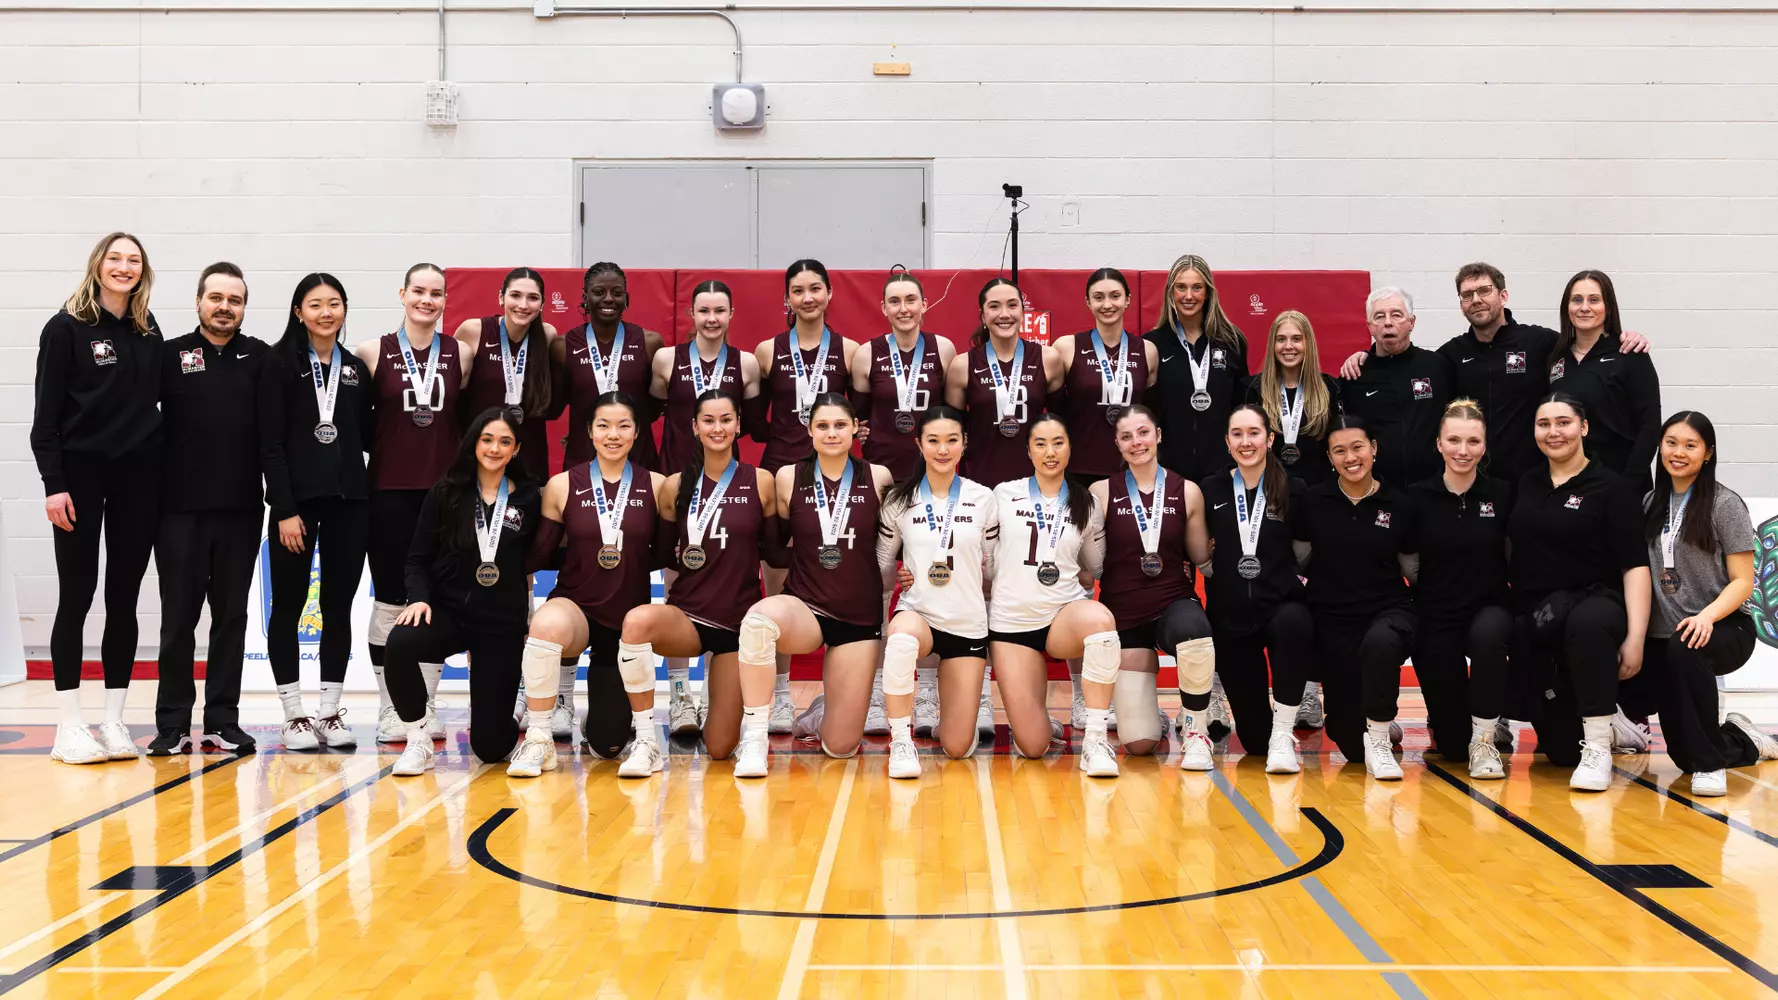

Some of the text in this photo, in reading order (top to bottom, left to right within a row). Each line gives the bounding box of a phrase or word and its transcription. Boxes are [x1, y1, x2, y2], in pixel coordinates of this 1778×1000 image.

[394, 362, 448, 370] McASER
[405, 351, 417, 375] OUA
[516, 349, 525, 374] OUA
[580, 354, 634, 364] McAER
[591, 346, 601, 371] OUA
[794, 352, 804, 378] OUA
[881, 362, 934, 372] McAER
[892, 353, 902, 376] OUA
[1087, 359, 1138, 368] McASER
[313, 362, 323, 388] OUA
[682, 374, 734, 382] McAER
[694, 366, 703, 391] OUA
[980, 375, 1033, 384] McAER
[992, 363, 1003, 387] OUA
[1102, 360, 1113, 383] OUA
[402, 373, 446, 412] 20
[582, 499, 644, 508] McATER
[596, 488, 606, 515] OUA
[690, 488, 699, 515] OUA
[816, 481, 826, 508] OUA
[926, 504, 936, 532] OUA
[1034, 503, 1046, 530] OUA
[1118, 506, 1176, 516] McSER
[1135, 505, 1148, 532] OUA
[1237, 494, 1246, 522] OUA
[709, 508, 728, 550] 4
